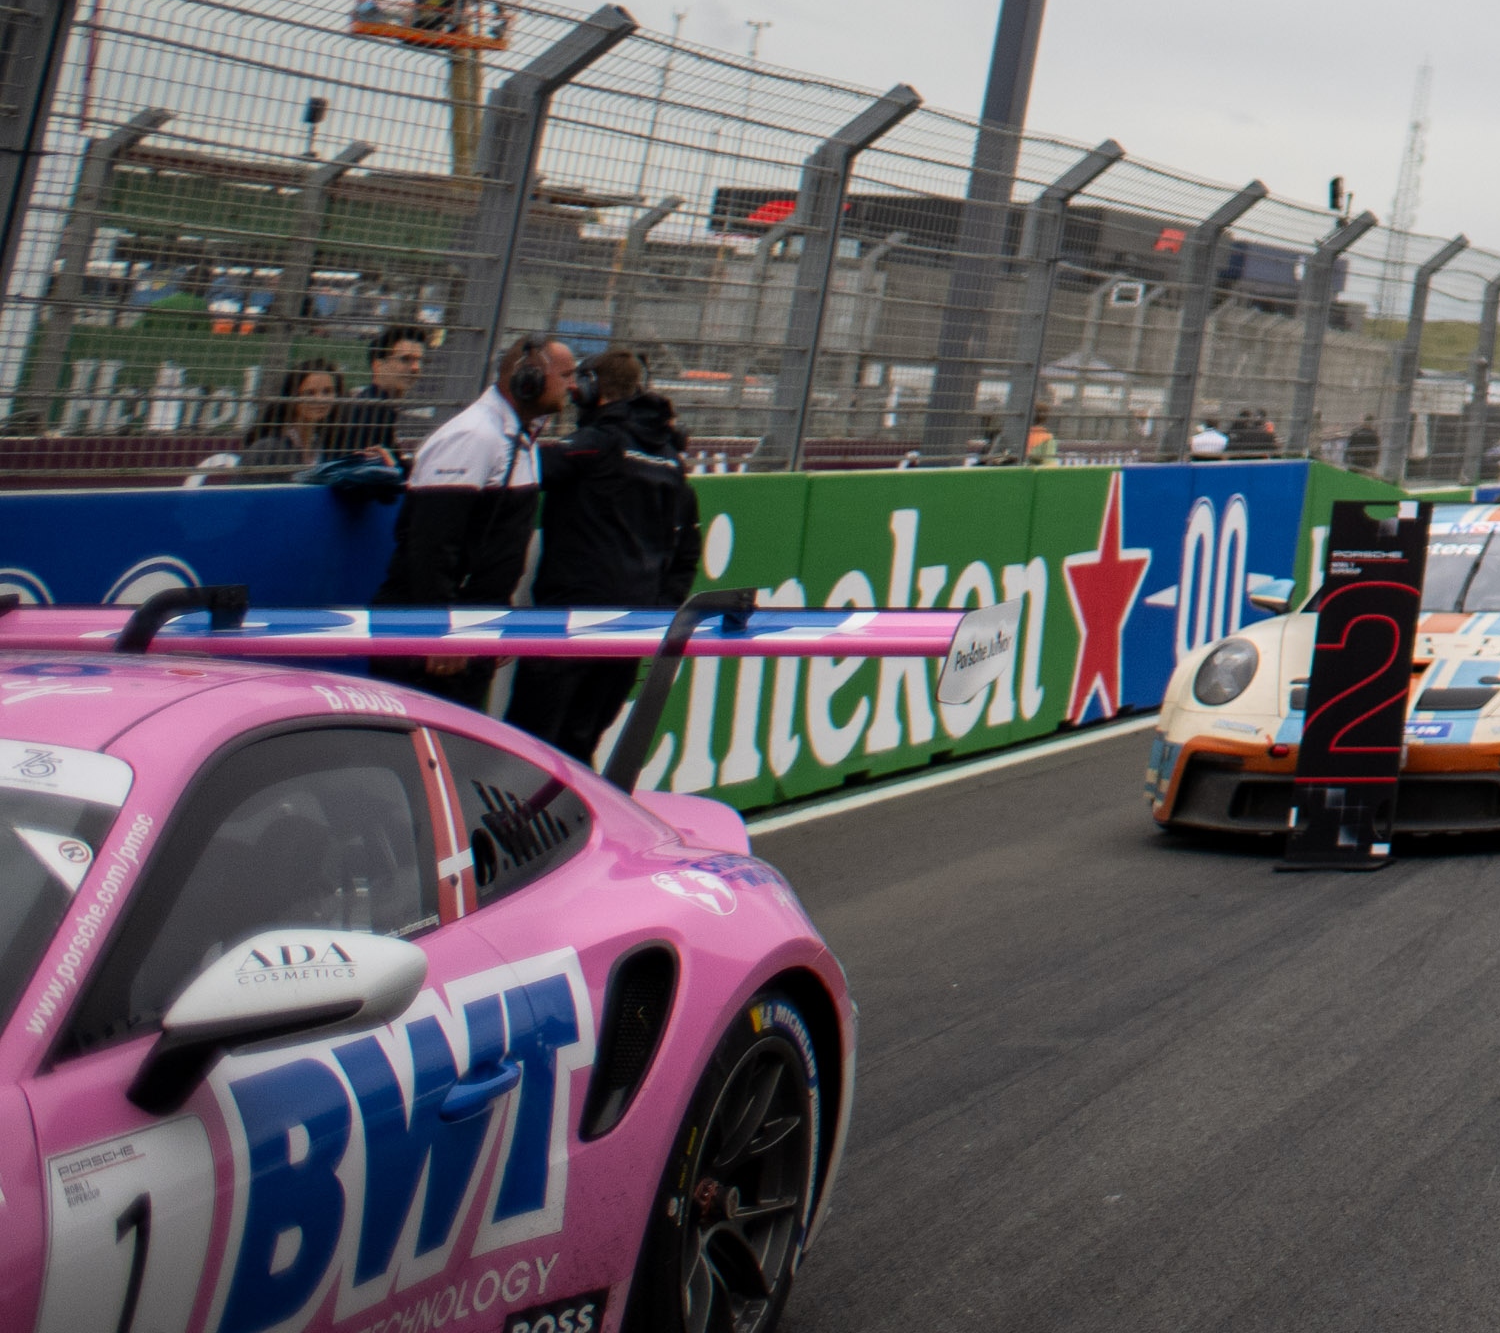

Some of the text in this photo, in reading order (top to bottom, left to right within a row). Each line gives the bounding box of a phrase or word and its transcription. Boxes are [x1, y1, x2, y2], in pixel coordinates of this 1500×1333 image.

[1426, 542, 1482, 556] ters
[595, 509, 1048, 793] ineken
[1302, 580, 1421, 753] 2
[25, 812, 154, 1038] www.porsche.com/pmsc
[233, 940, 353, 970] ADA
[236, 965, 360, 986] COSMETICS
[57, 1144, 136, 1178] PORSCHE
[206, 971, 583, 1333] BWT
[114, 1190, 153, 1333] 1
